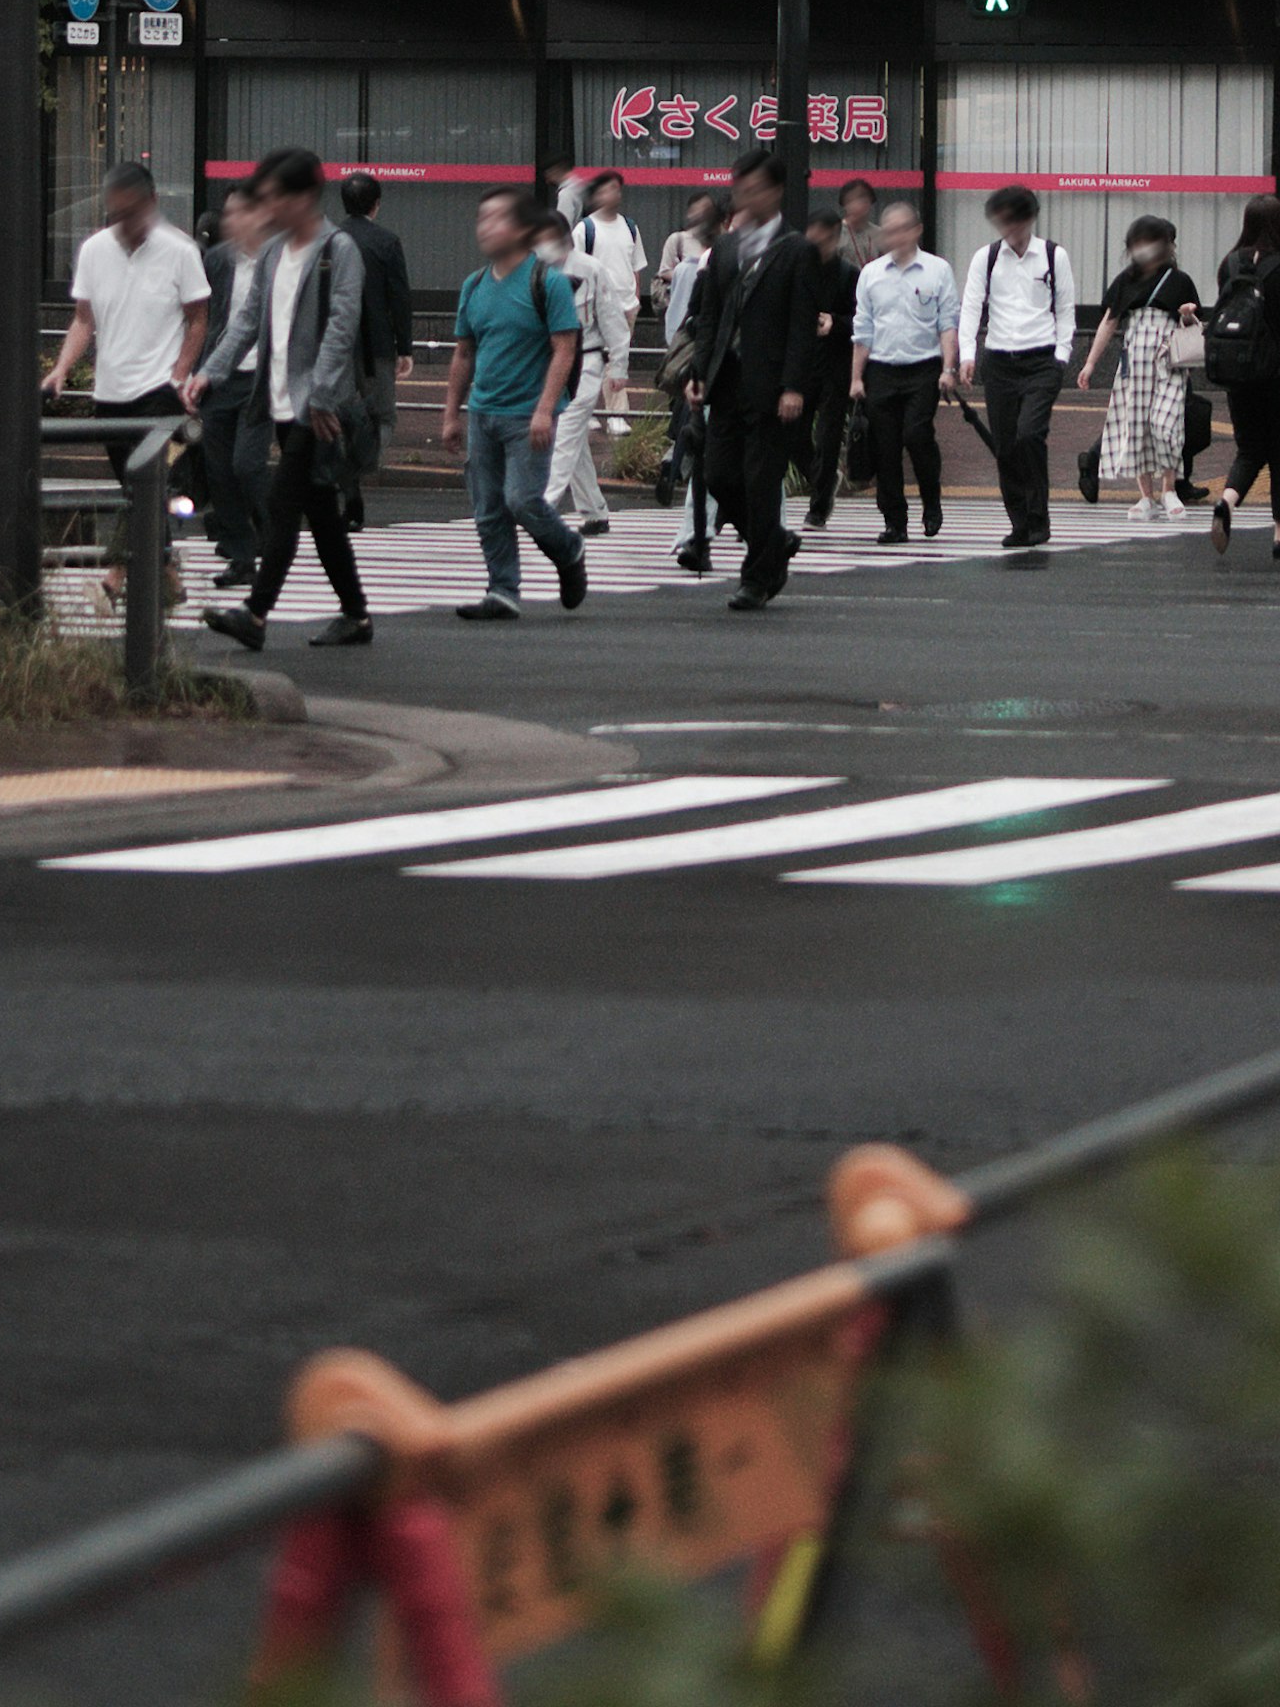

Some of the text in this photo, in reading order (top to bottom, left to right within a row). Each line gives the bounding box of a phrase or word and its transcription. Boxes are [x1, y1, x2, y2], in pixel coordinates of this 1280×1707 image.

[69, 27, 97, 40] ここから
[143, 29, 179, 41] ここまで
[657, 93, 888, 144] さくら薬局
[378, 167, 426, 177] PHARMACY
[1058, 177, 1151, 188] SAKURA PHARMACY
